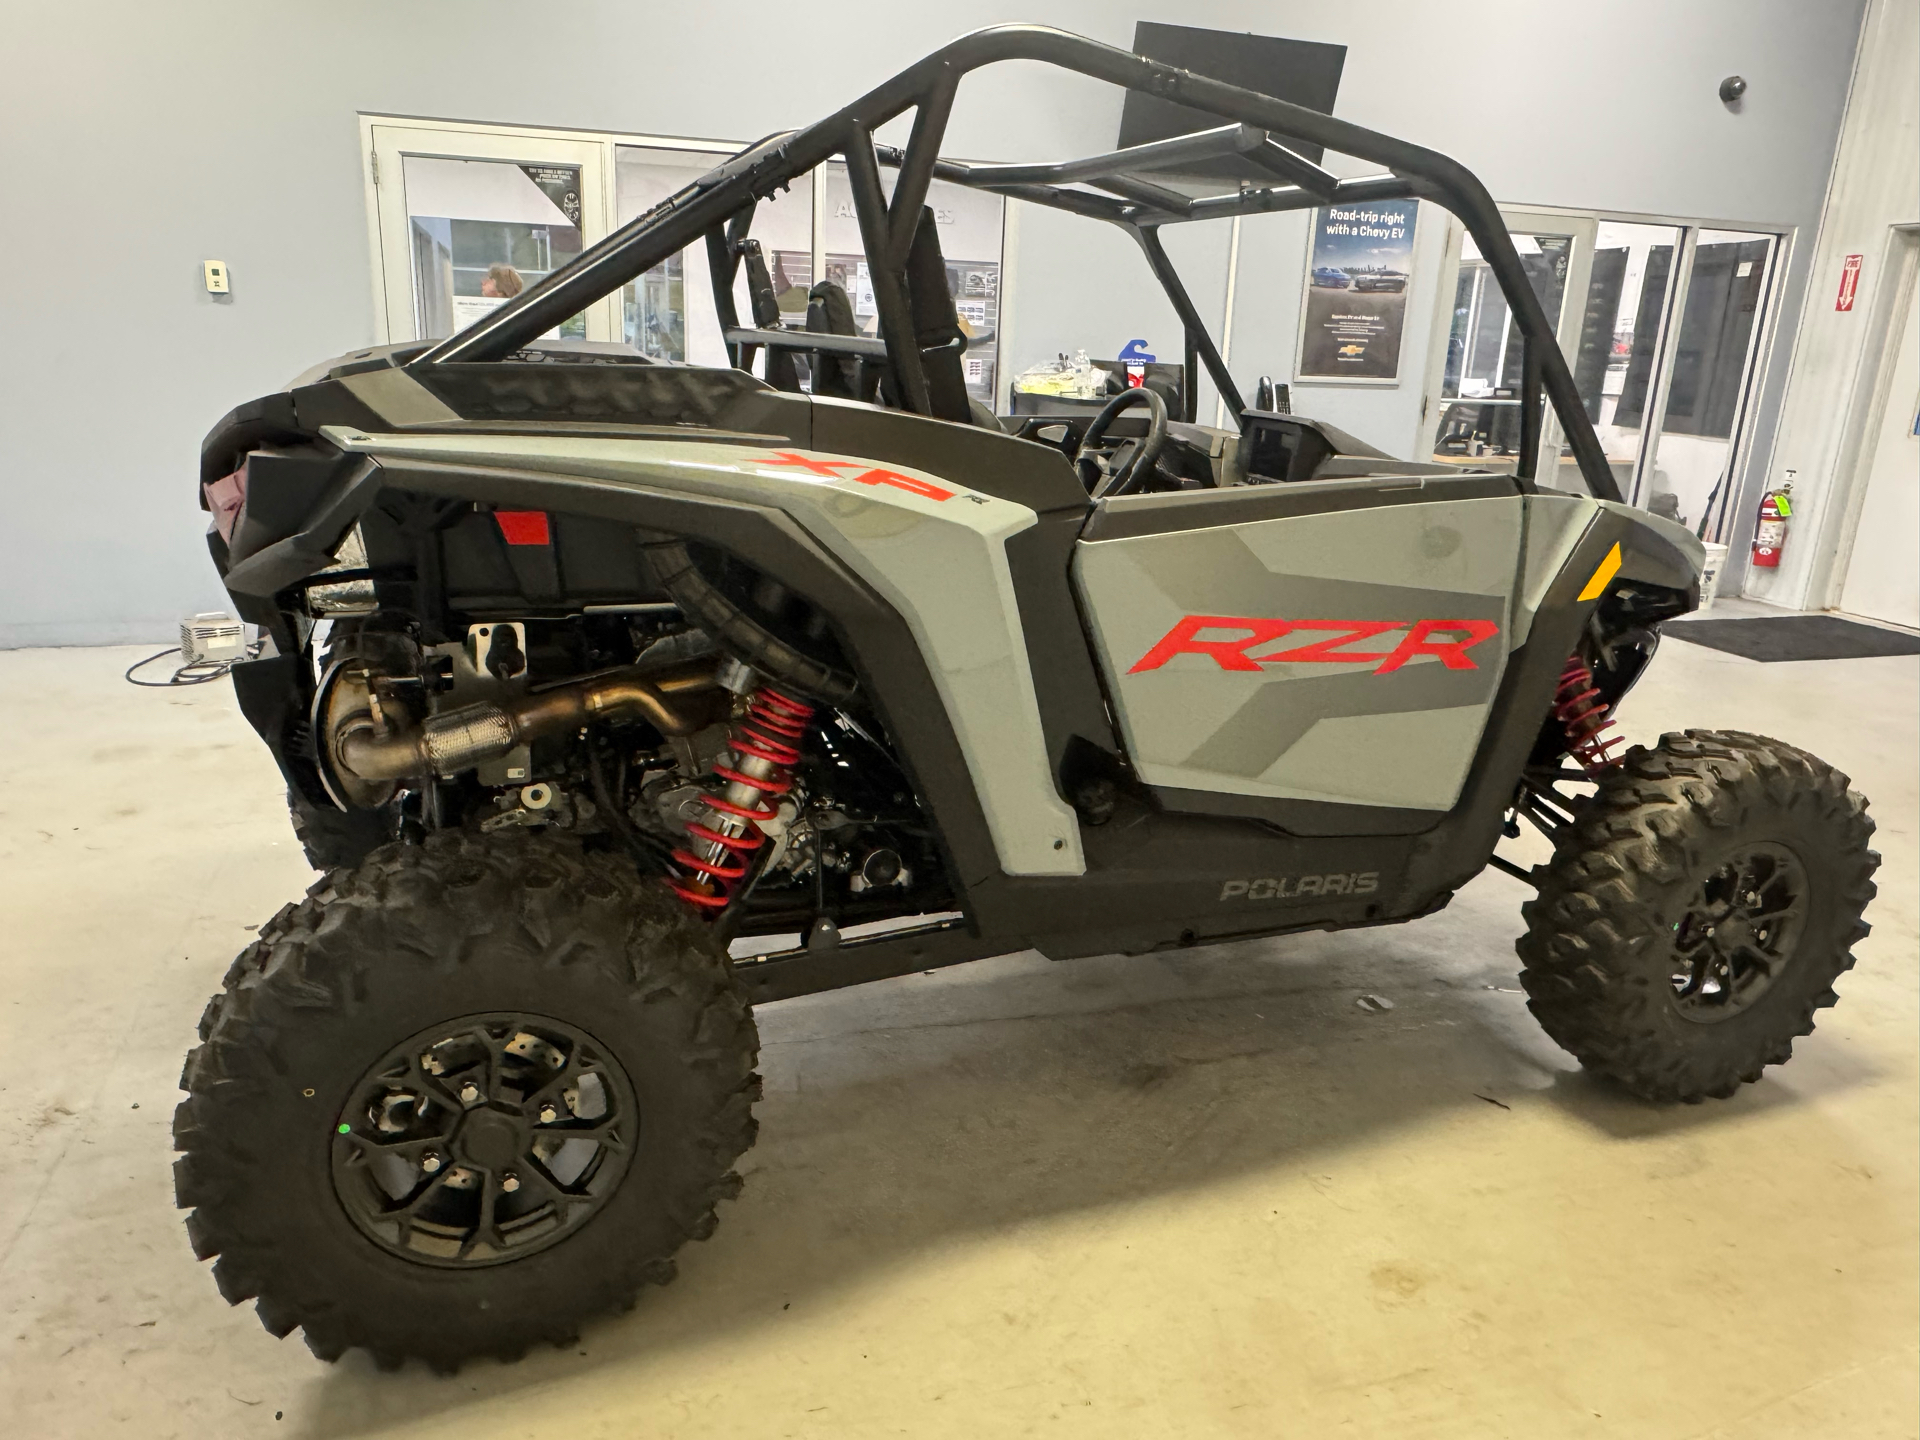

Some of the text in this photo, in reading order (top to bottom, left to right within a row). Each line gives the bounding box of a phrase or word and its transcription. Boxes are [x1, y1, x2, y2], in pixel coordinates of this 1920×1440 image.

[1326, 223, 1406, 240] with a Chevy EV
[1329, 208, 1406, 226] Road-trip right
[743, 450, 958, 502] XP
[1126, 615, 1500, 675] RZR
[1219, 871, 1380, 902] POLARIS
